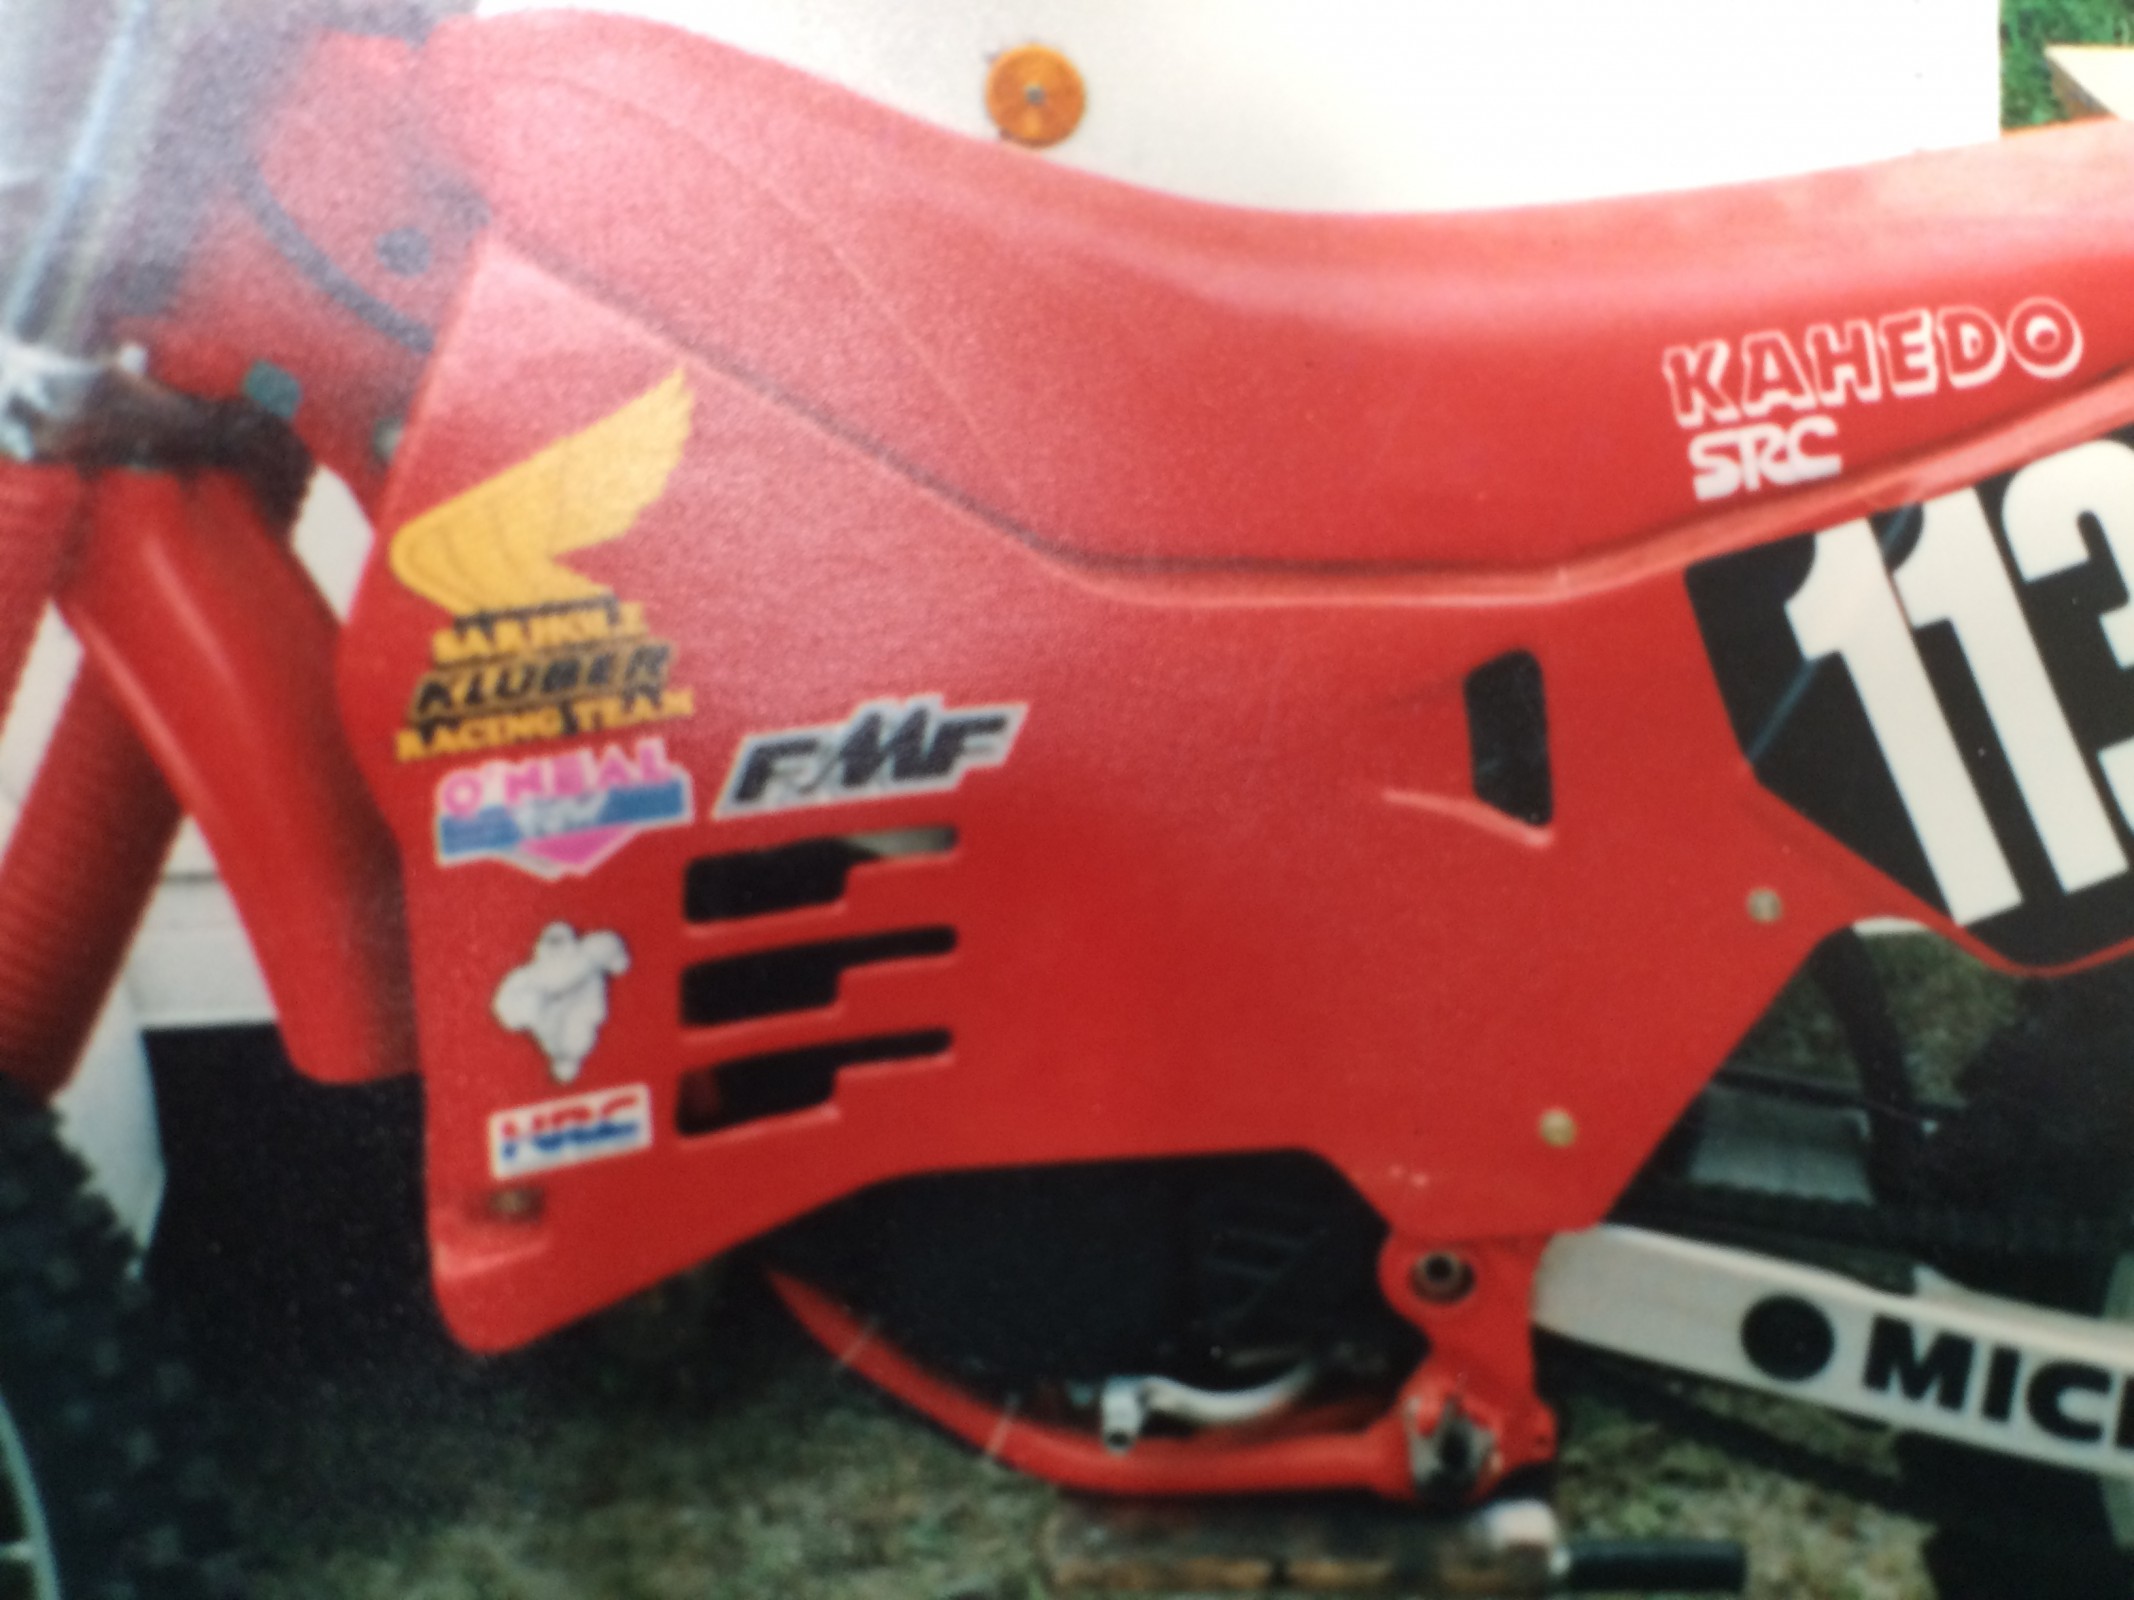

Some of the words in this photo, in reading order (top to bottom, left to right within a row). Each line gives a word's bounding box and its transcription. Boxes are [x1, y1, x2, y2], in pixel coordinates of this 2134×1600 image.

[1662, 296, 2084, 428] KAHEDO
[1689, 415, 1842, 501] SRC
[1784, 440, 2134, 927] 113
[728, 699, 1014, 808] FMF
[1862, 1312, 2134, 1451] MIC
